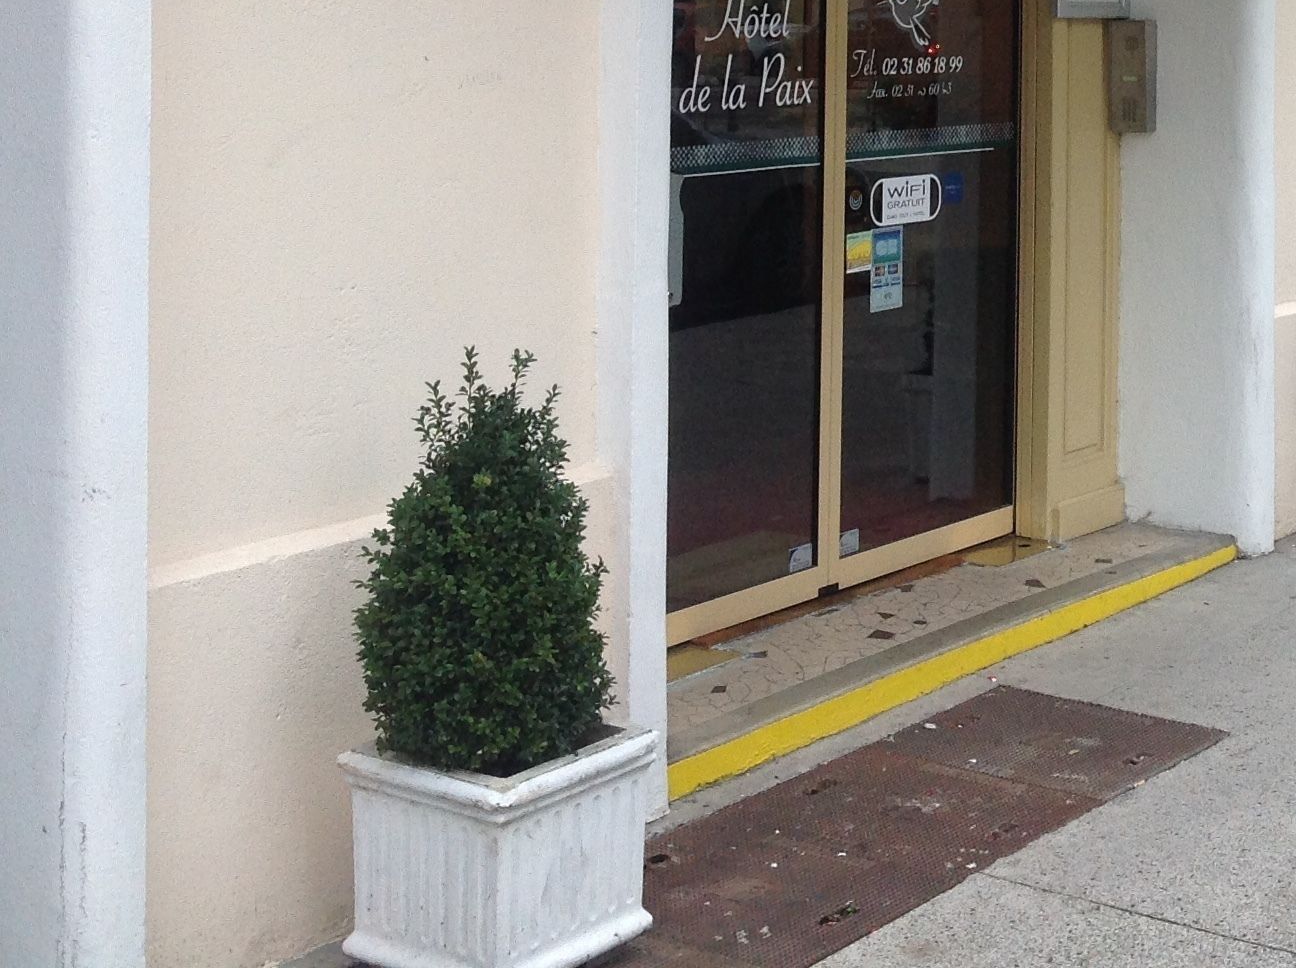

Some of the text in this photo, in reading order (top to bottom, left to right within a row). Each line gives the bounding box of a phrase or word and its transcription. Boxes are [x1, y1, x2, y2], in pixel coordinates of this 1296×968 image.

[882, 57, 898, 75] 02
[900, 57, 913, 75] 31
[933, 56, 947, 74] 18
[949, 55, 964, 73] 99
[679, 52, 815, 114] de la Paix
[887, 197, 926, 210] GRATUIT
